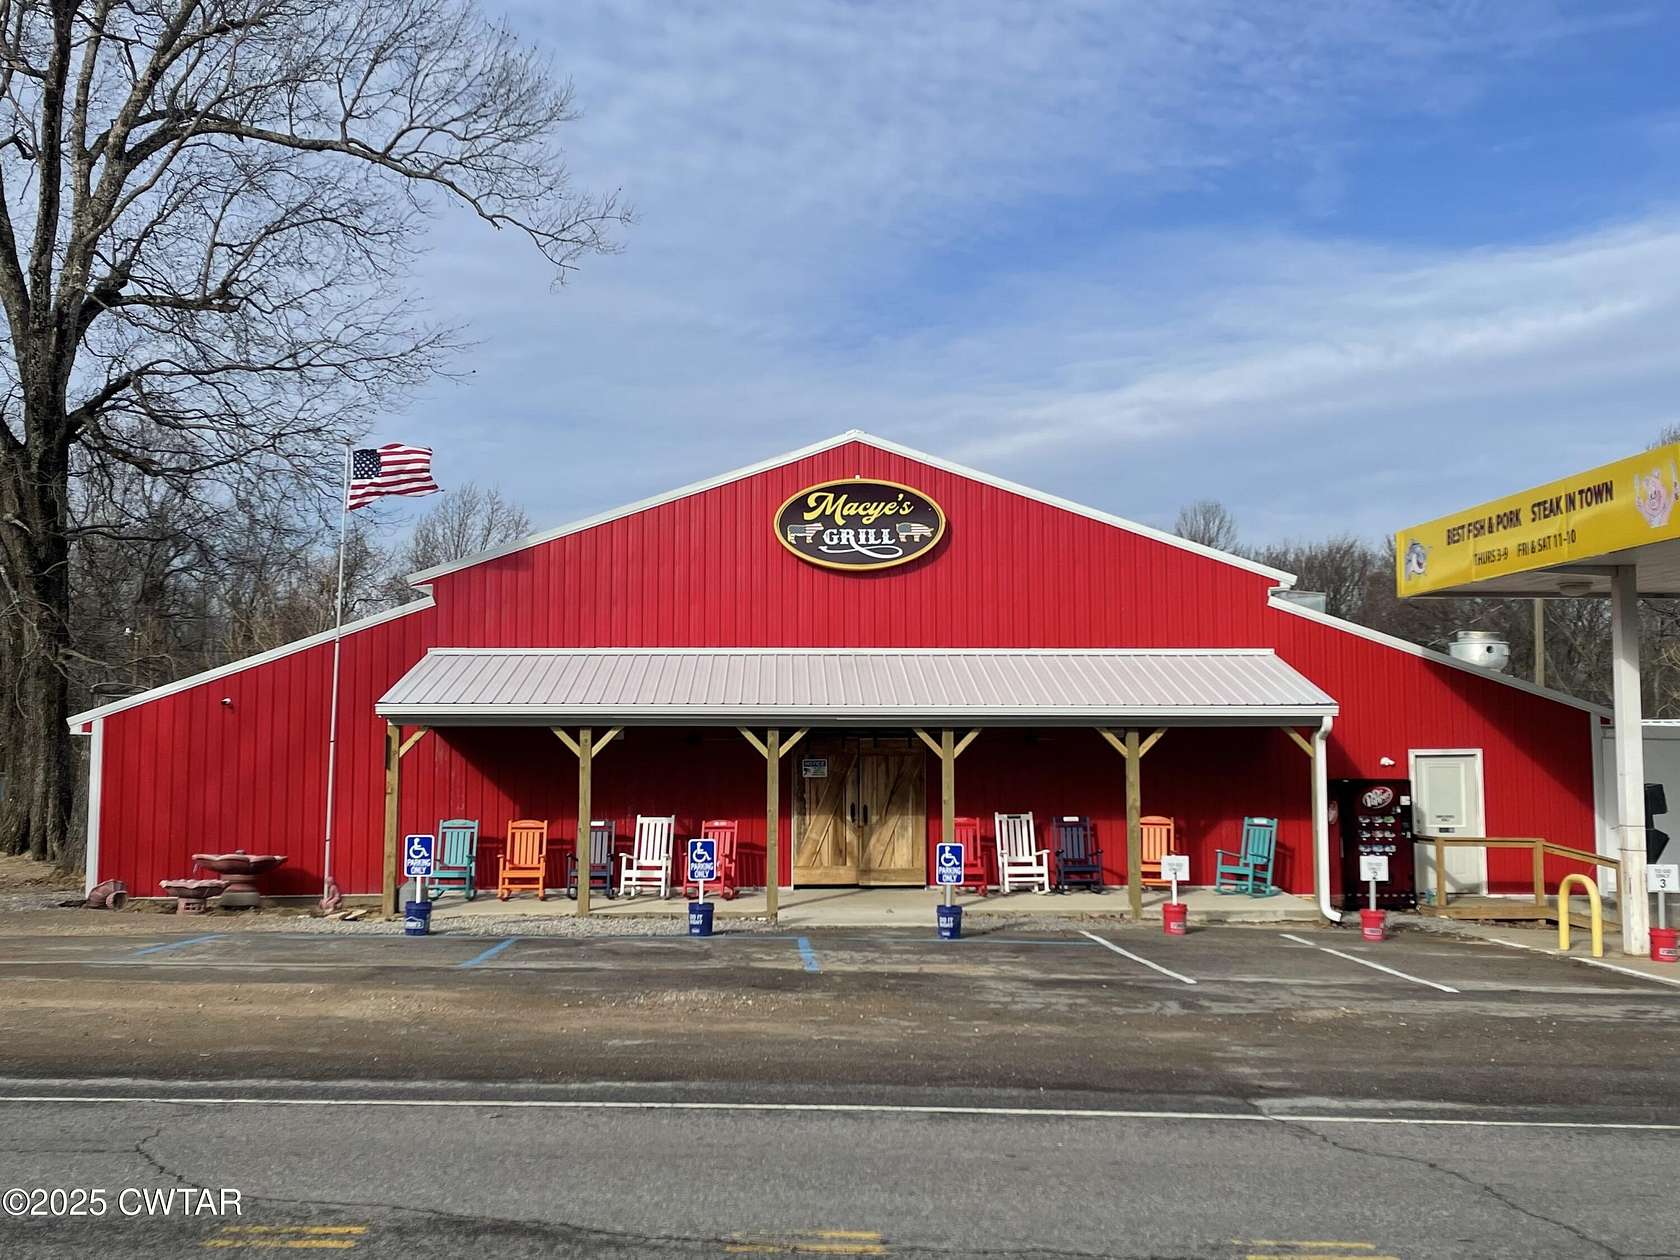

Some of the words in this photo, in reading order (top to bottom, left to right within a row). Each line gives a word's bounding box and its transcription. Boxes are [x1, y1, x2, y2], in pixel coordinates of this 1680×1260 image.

[803, 492, 914, 526] Macye's
[1446, 524, 1465, 545] BEST
[1467, 519, 1486, 541] FISH
[1496, 508, 1521, 532] PORK
[1531, 495, 1563, 522] STEAK
[1565, 491, 1576, 513] IN
[1578, 480, 1613, 509] TOWN
[820, 528, 899, 556] GRILL
[1517, 542, 1530, 557] FRI
[1538, 534, 1552, 552] SAT
[1553, 528, 1577, 548] 11-10
[690, 863, 713, 871] PARKING
[938, 867, 961, 875] PARKING
[694, 870, 710, 878] ONLY
[942, 874, 957, 882] ONLY
[1660, 879, 1666, 889] 3
